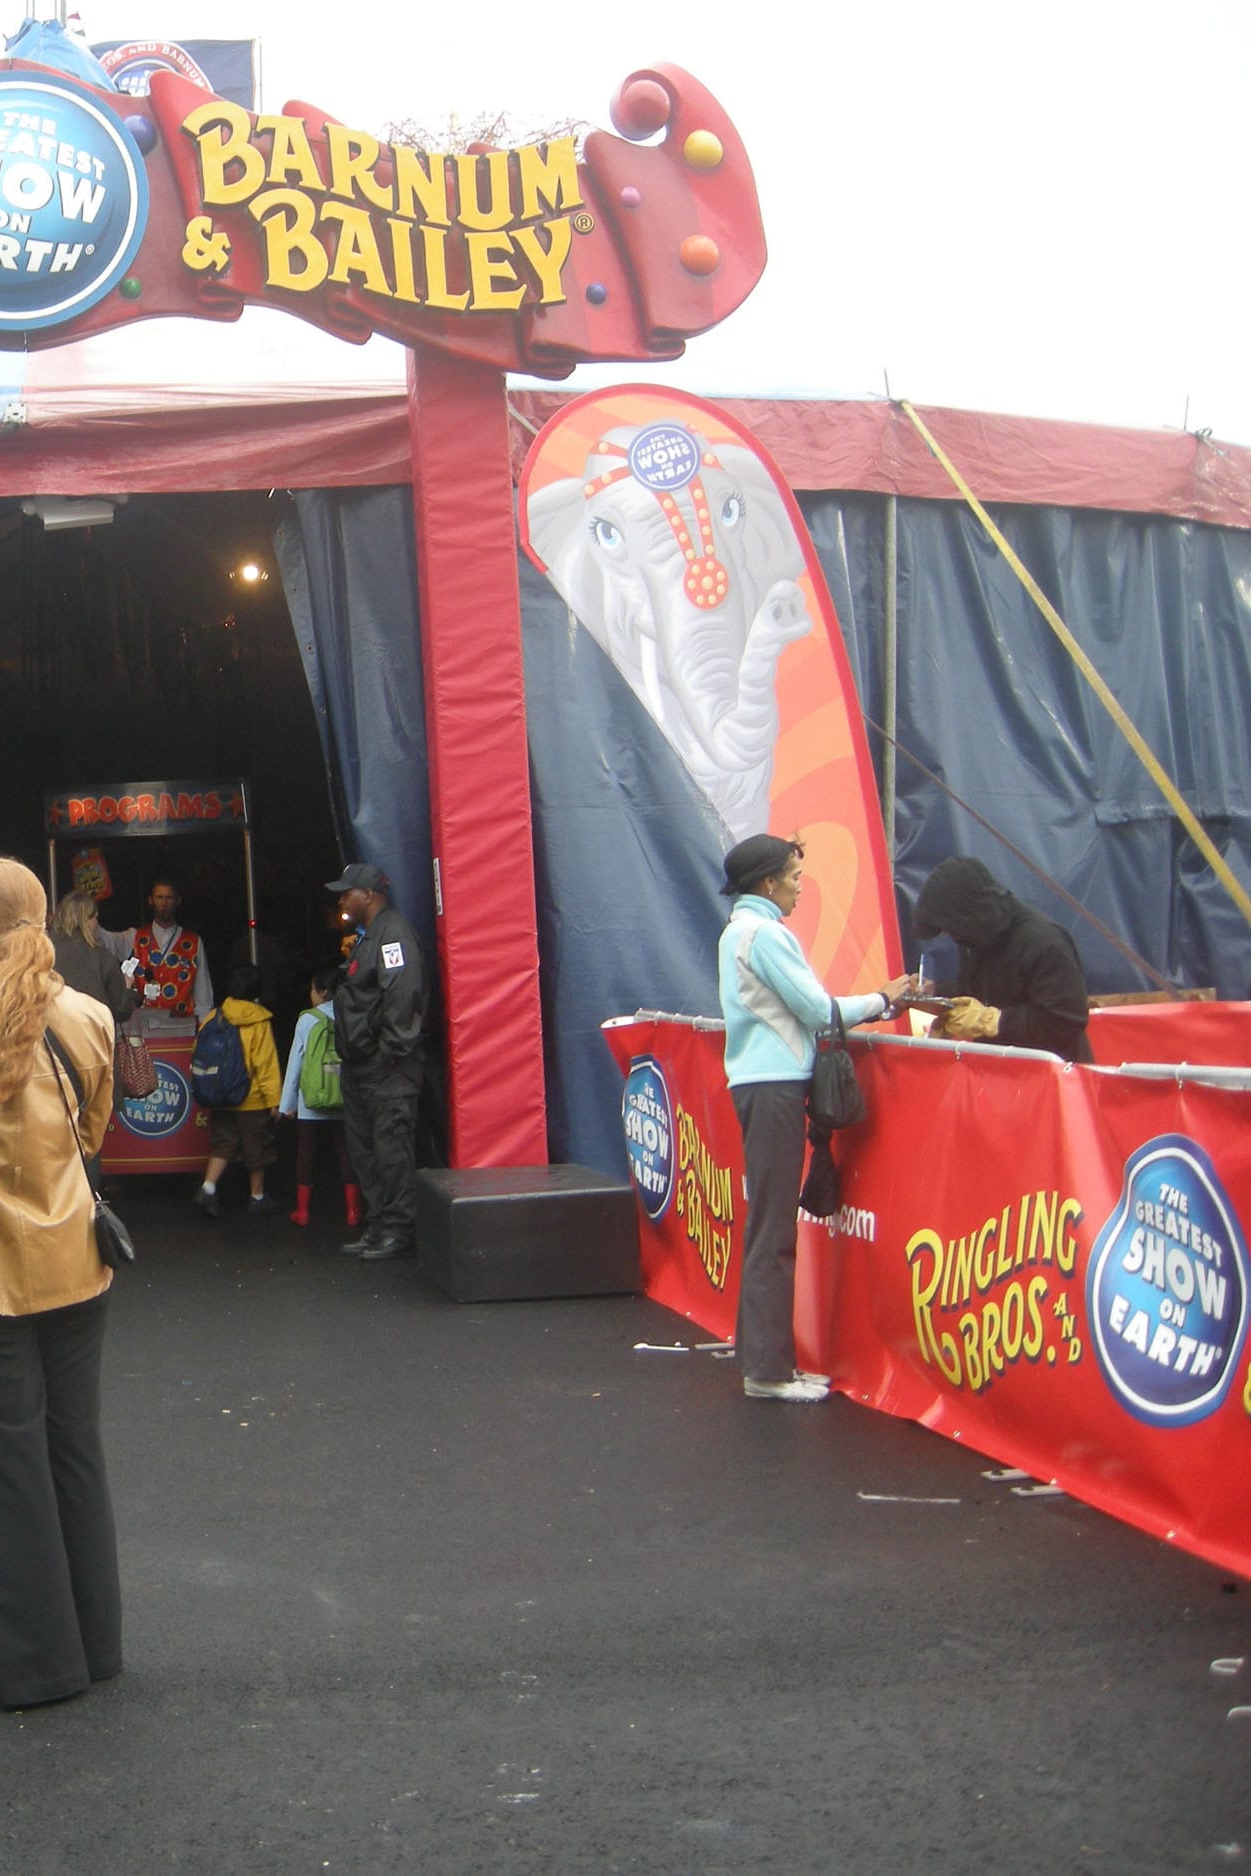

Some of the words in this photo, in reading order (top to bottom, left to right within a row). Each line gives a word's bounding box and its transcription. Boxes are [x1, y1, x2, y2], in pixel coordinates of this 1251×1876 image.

[4, 112, 57, 135] THE
[182, 101, 584, 231] BARNUM
[182, 216, 231, 271] &
[249, 187, 573, 312] BAILEY
[68, 792, 222, 825] PROGRAMS
[126, 1107, 175, 1123] EARTH
[144, 1103, 157, 1111] ON
[626, 1110, 669, 1160] SHOW
[642, 1151, 654, 1166] ON
[676, 1103, 733, 1221] BARNUM
[1159, 1183, 1188, 1215] THE
[686, 1169, 732, 1290] BAILEY
[1135, 1200, 1222, 1268] GREATEST
[905, 1191, 1082, 1385] RINGLING
[1122, 1228, 1227, 1320] SHOW
[958, 1276, 1056, 1390] BROS.
[1160, 1298, 1186, 1329] ON
